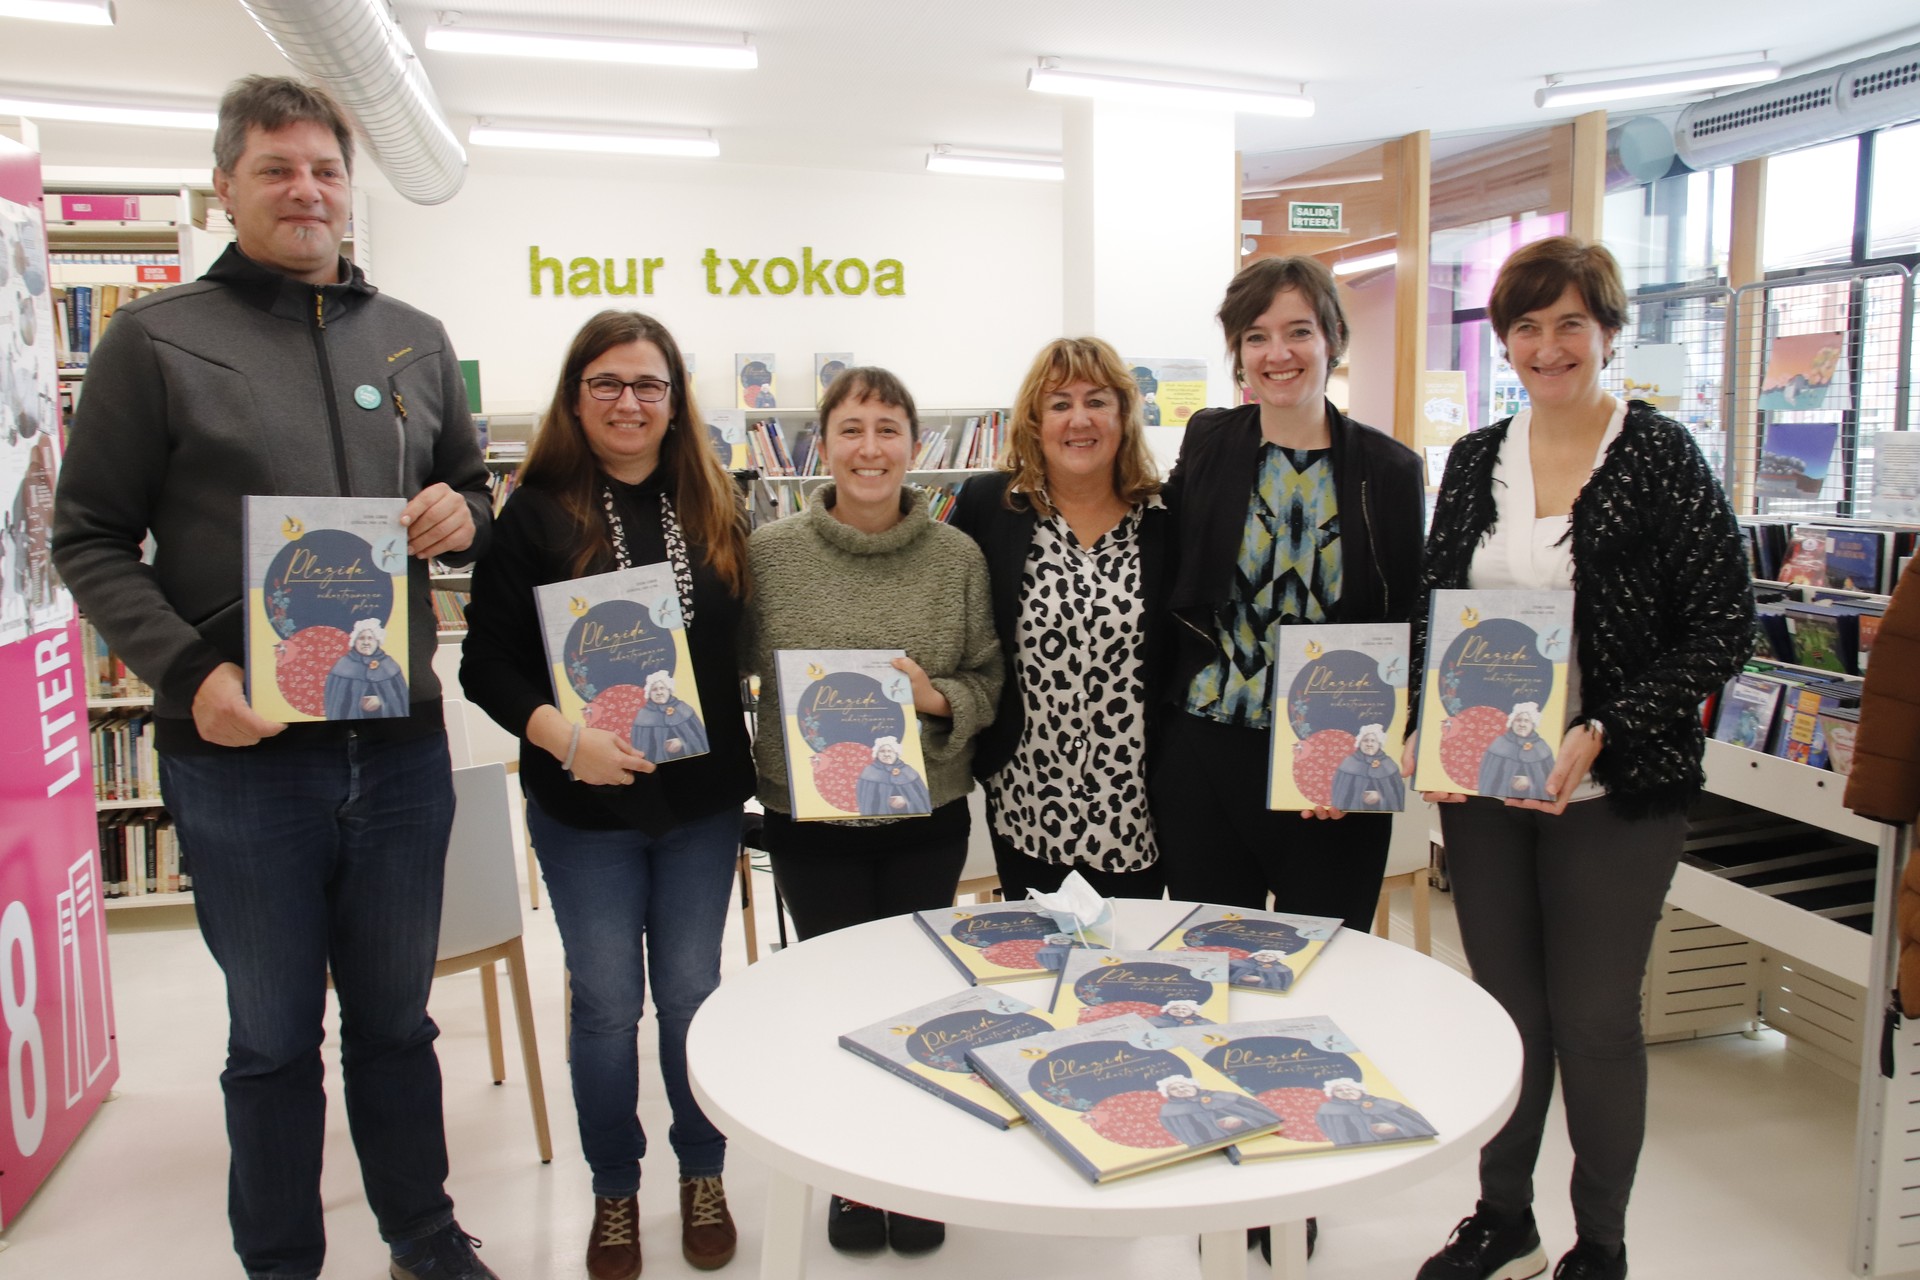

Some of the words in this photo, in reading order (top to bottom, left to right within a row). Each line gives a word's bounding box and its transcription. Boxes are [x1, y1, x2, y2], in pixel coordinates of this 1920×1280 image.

[1293, 217, 1336, 227] IRTEERA
[1296, 208, 1333, 217] SALIDA
[529, 245, 664, 297] haur
[701, 246, 906, 297] txokoa
[284, 548, 368, 589] Plazida
[579, 620, 647, 656] Plazida
[1456, 635, 1531, 672] Plazida
[1303, 665, 1374, 699] Plazida
[35, 631, 81, 798] LITER
[812, 685, 879, 715] Plazida
[1207, 922, 1286, 938] Plazida
[1097, 968, 1182, 990] Plazida
[0, 901, 47, 1157] 8
[921, 1017, 998, 1053] Plazida
[1049, 1050, 1135, 1084] Plazida
[1223, 1047, 1311, 1070] Plazida
